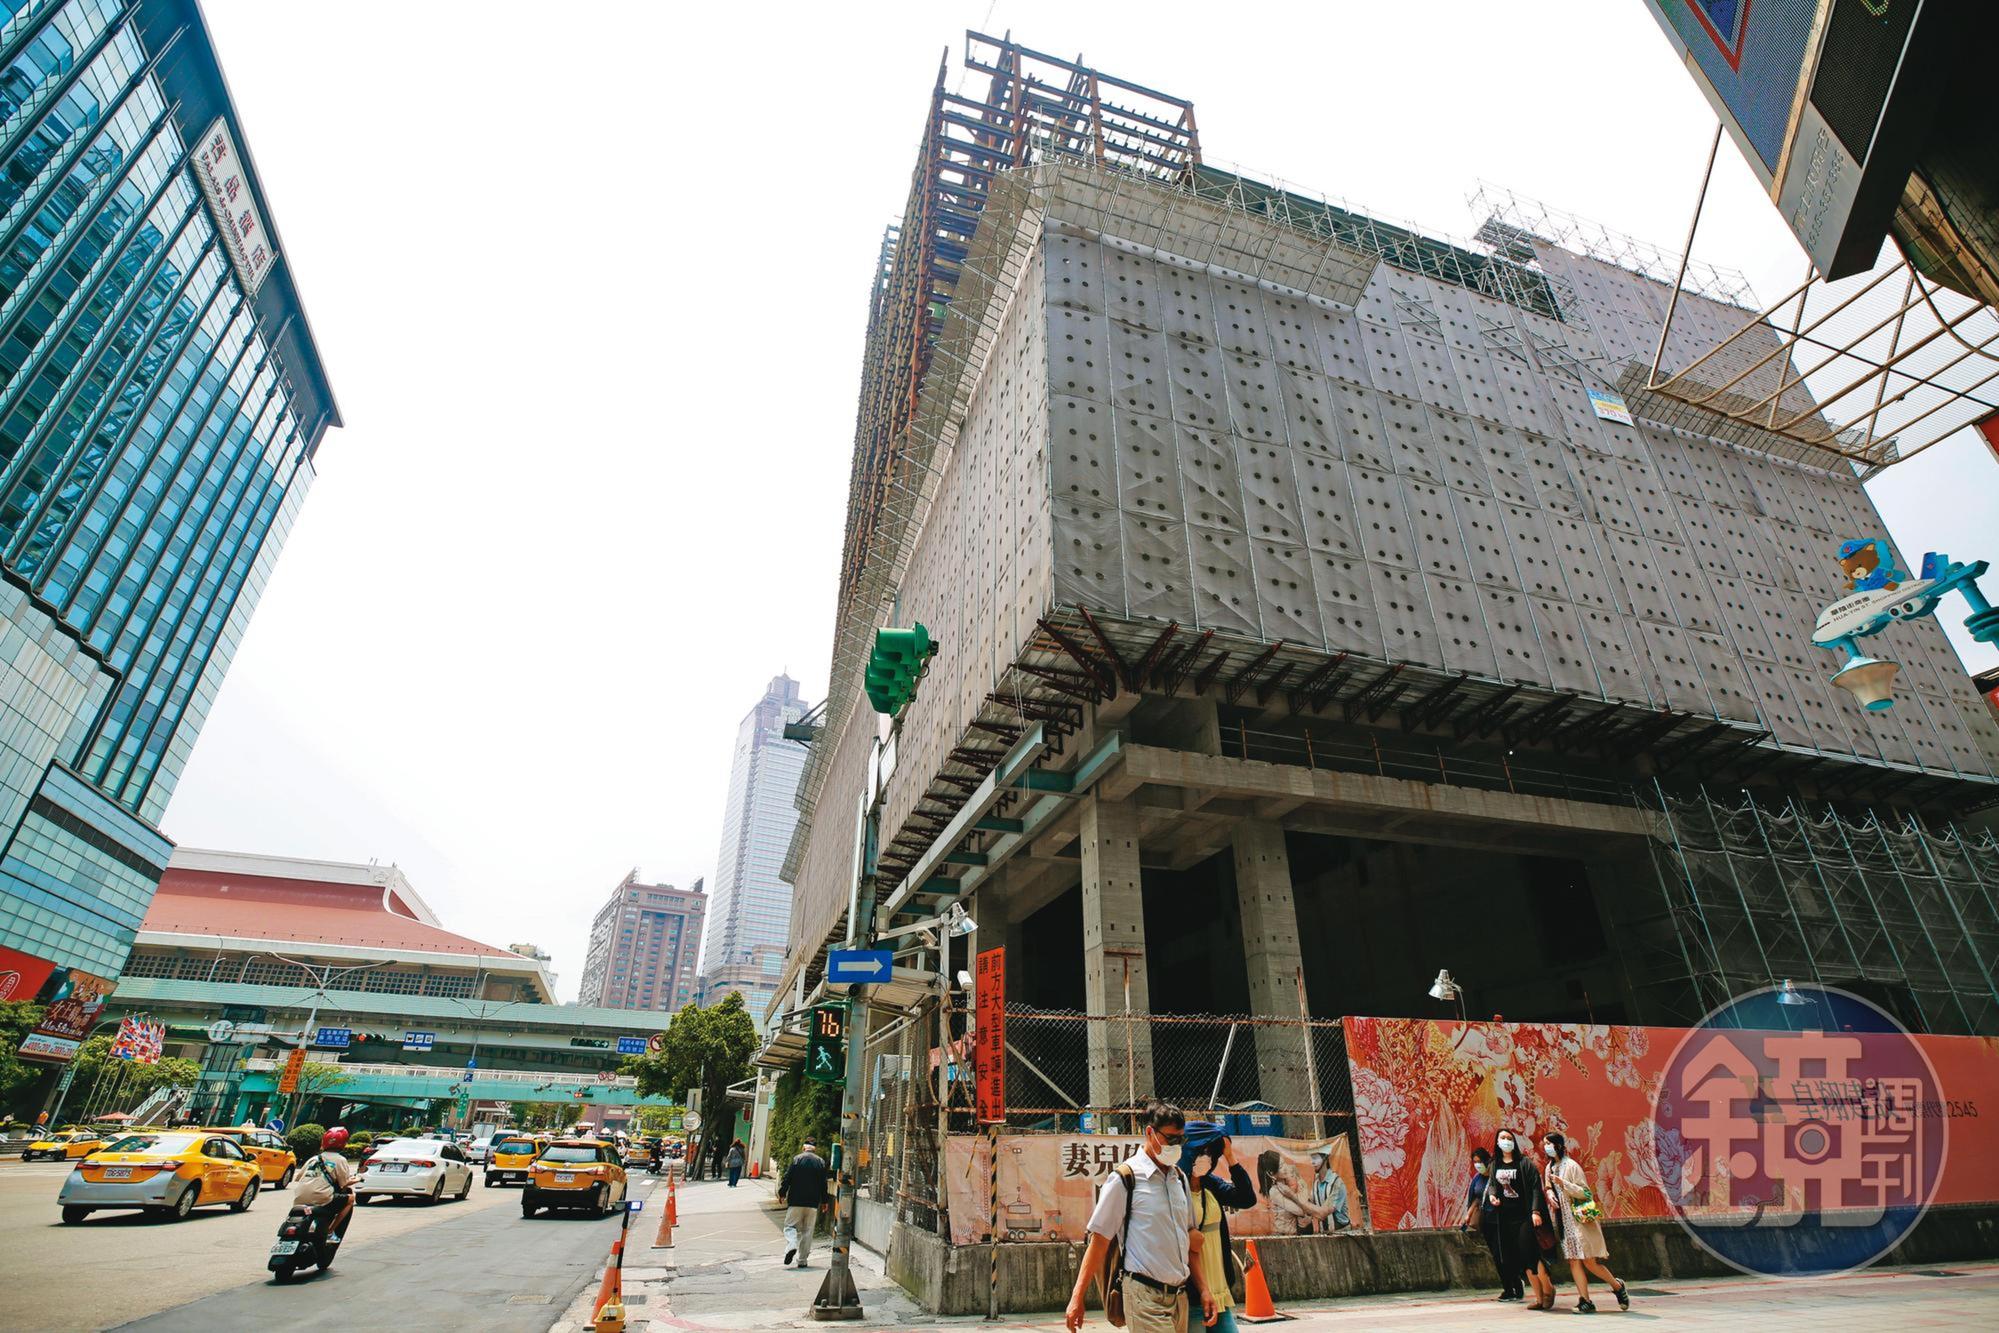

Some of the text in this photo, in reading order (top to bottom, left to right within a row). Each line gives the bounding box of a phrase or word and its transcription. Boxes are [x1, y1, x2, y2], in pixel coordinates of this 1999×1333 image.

[211, 133, 266, 270] 君品酒店
[817, 1010, 840, 1037] 76
[978, 957, 988, 1119] 請注意安全
